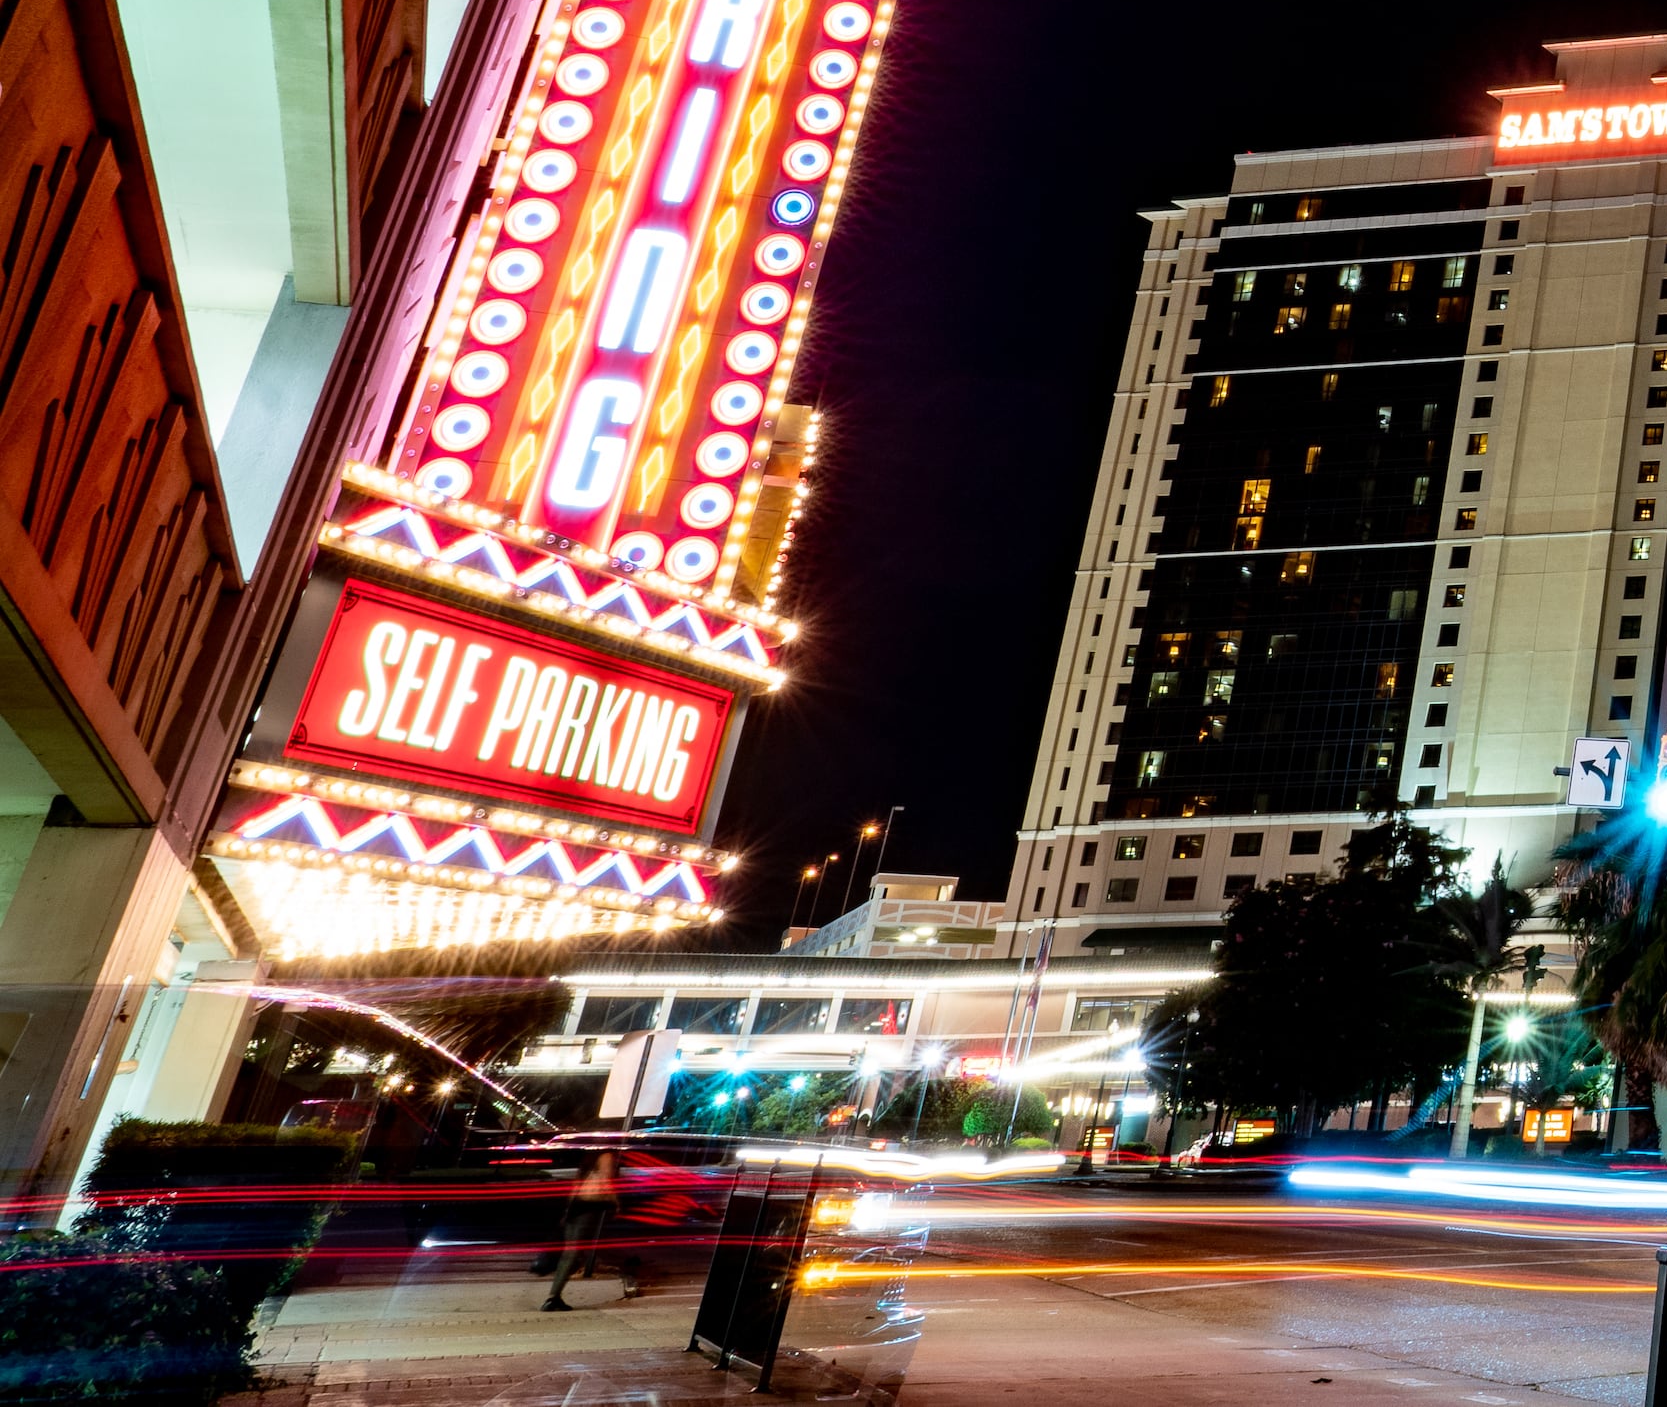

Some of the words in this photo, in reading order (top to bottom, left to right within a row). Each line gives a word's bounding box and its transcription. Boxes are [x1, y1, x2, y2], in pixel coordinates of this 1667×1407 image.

[1498, 106, 1603, 148] SAM'S
[337, 620, 493, 752] SELF
[477, 655, 701, 802] PARKING
